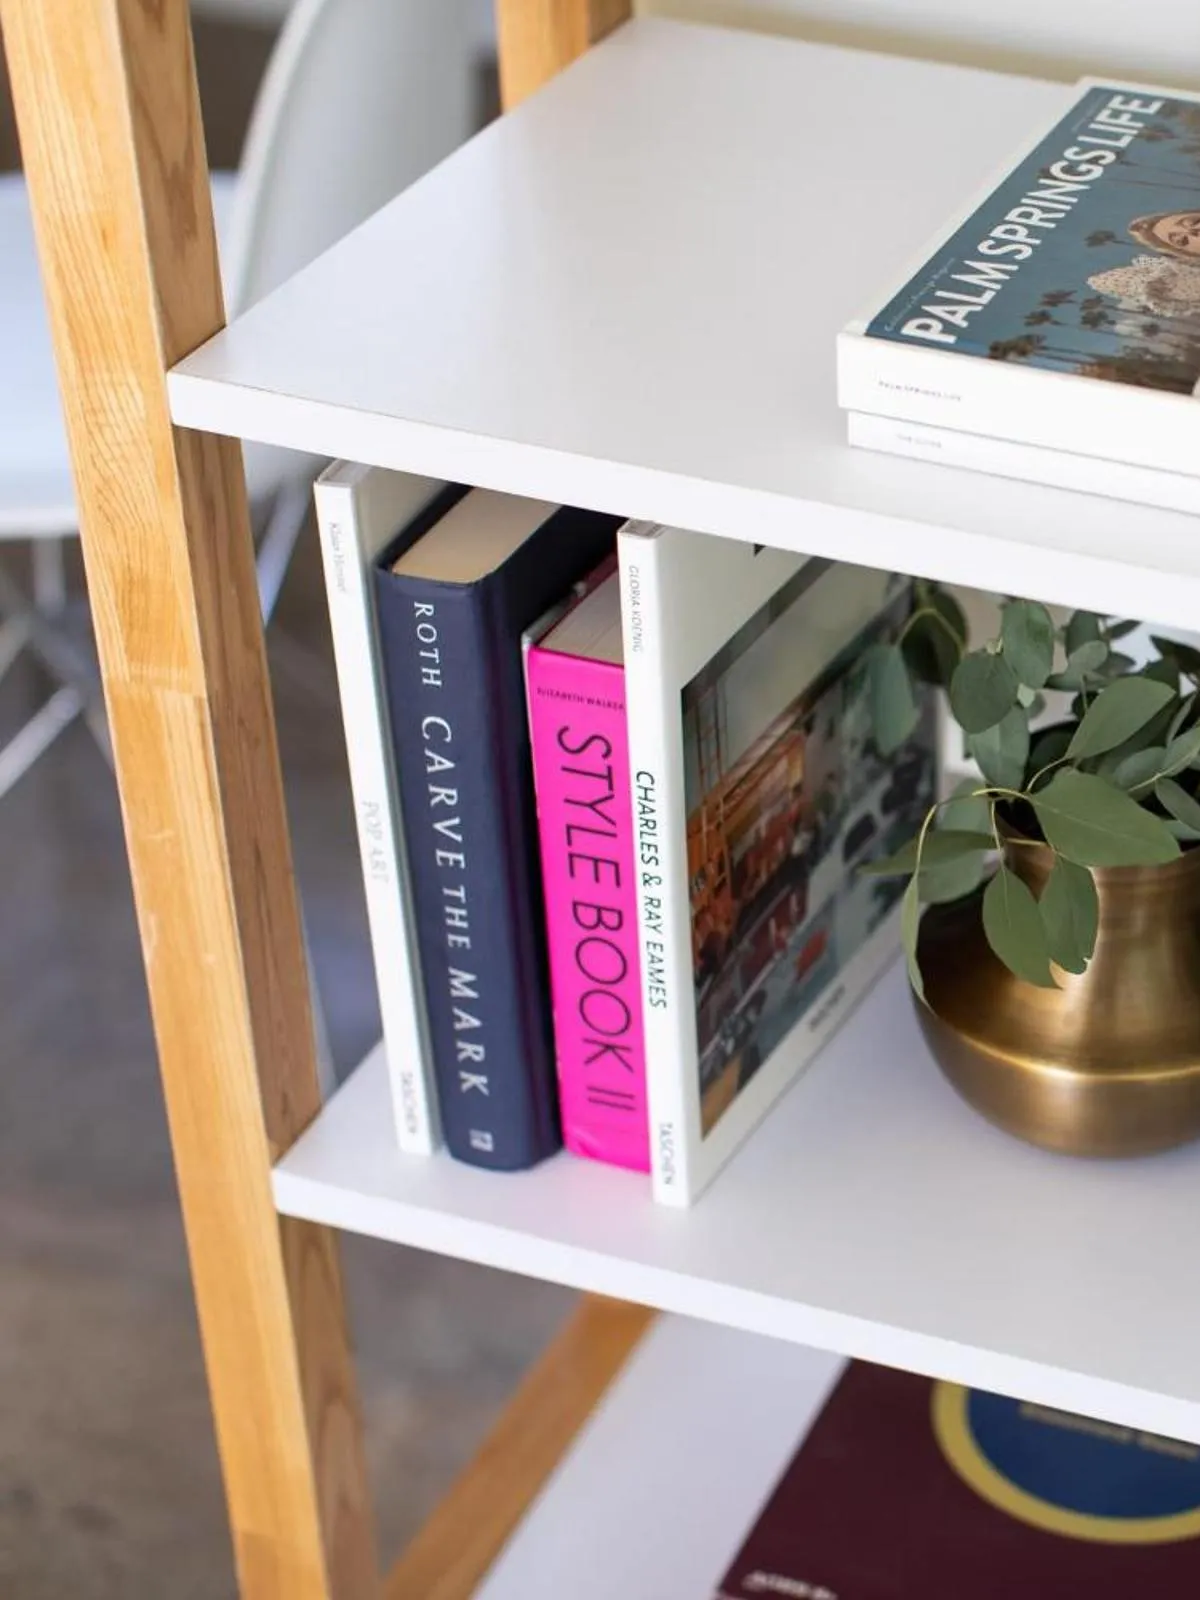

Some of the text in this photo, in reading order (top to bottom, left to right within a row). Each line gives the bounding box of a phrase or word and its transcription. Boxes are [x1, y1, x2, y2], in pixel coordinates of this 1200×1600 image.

[901, 260, 1018, 344] PALM
[977, 146, 1117, 260] SPRINGS
[1077, 95, 1166, 148] LIFE
[414, 601, 442, 687] ROTH
[420, 716, 490, 1097] CARVE THE MARK
[556, 725, 636, 1112] STYLE BOOK II
[635, 770, 667, 1010] CHARLES & RAY EAMES
